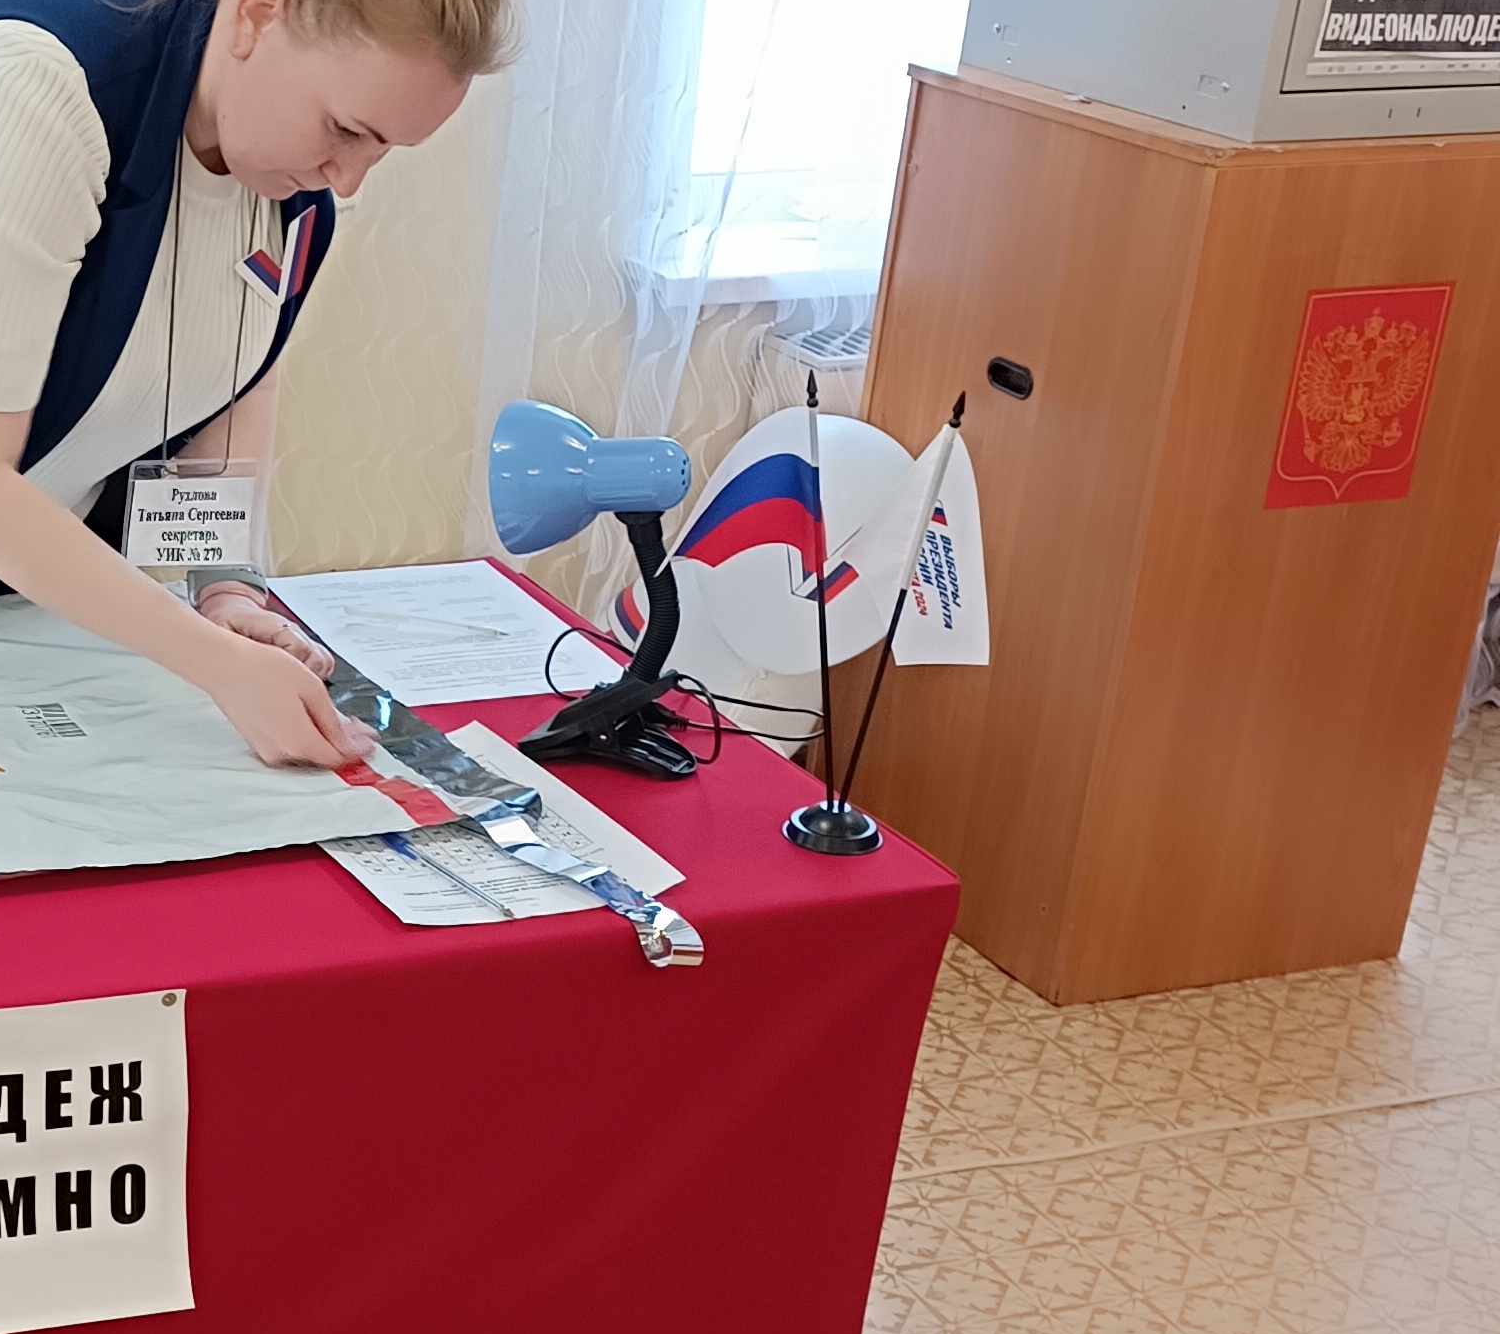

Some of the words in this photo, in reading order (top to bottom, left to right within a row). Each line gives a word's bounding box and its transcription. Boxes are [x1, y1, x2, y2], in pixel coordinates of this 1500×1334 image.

[171, 488, 217, 505] Рухлова
[137, 508, 185, 522] Татьяна
[188, 508, 246, 524] Сергеевна
[161, 530, 219, 545] секретарь
[156, 548, 185, 562] УИК
[187, 547, 201, 562] №
[203, 547, 223, 562] 279
[939, 533, 962, 609] ВЫБОРЫ
[925, 529, 953, 630] ПРЕЗИДЕНТА
